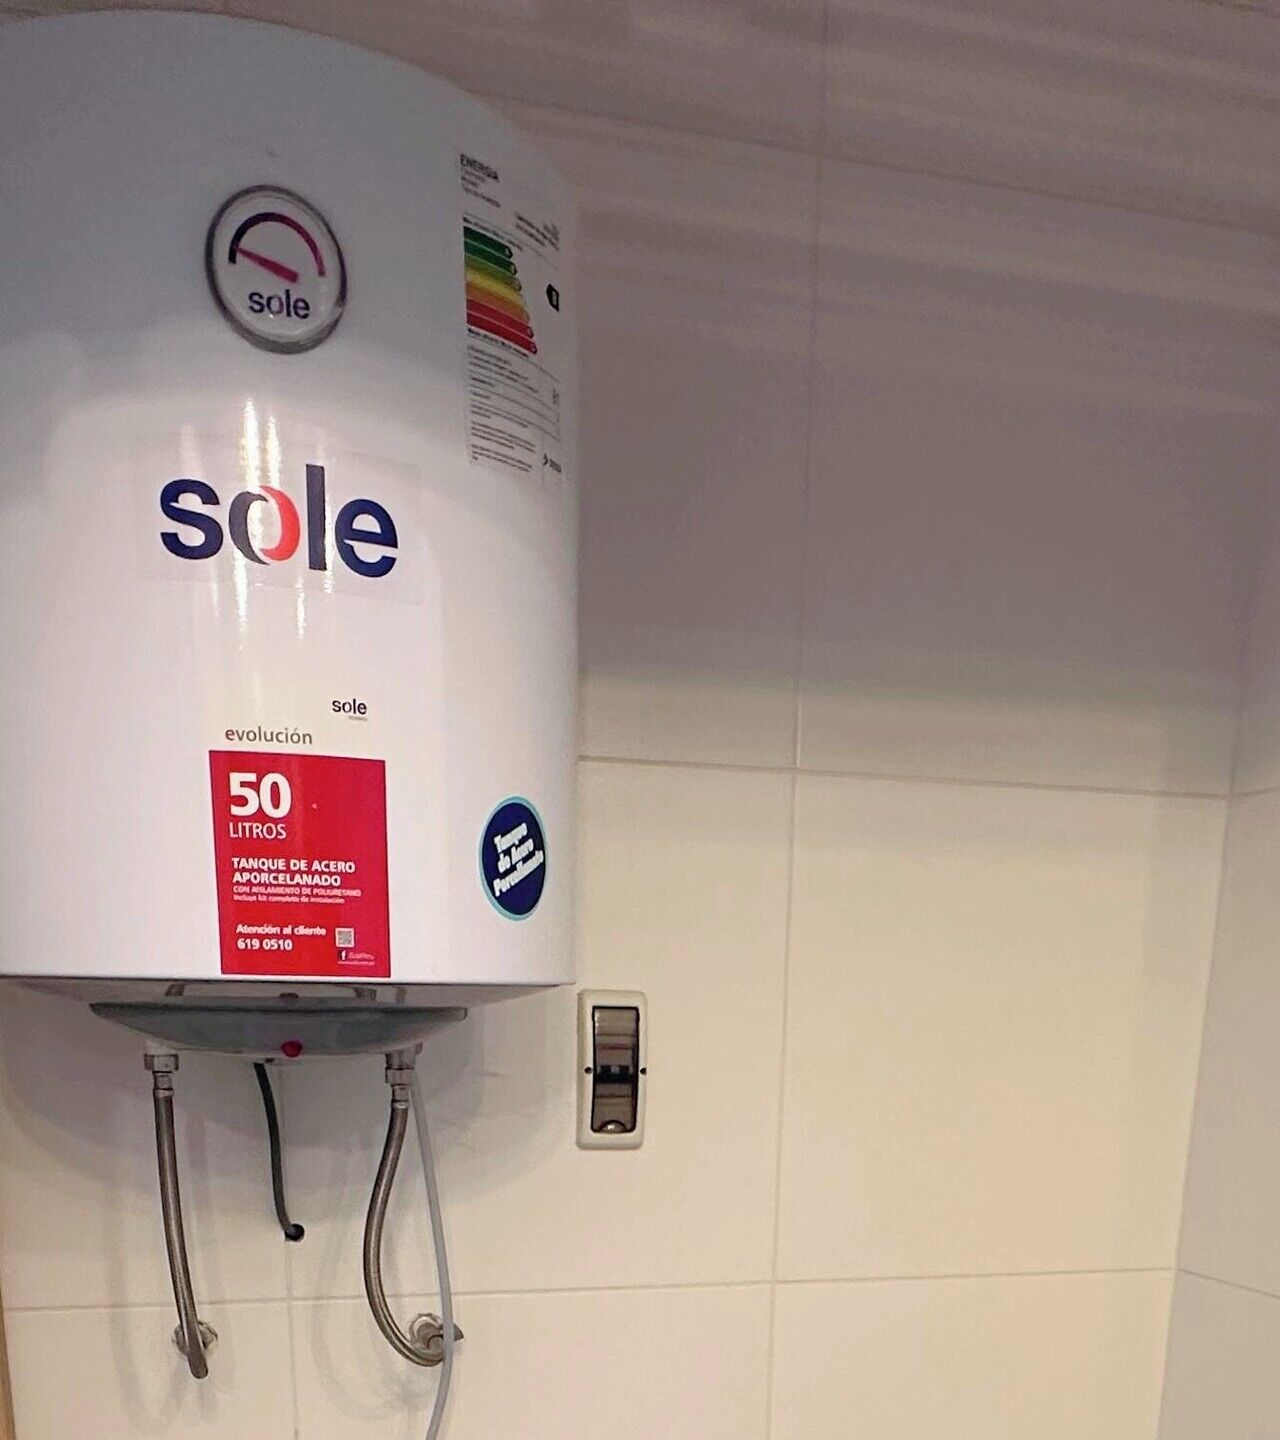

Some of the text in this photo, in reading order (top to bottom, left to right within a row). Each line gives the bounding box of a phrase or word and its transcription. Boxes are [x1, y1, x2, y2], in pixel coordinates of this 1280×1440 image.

[248, 289, 310, 319] sole
[160, 464, 398, 578] sole
[331, 698, 367, 715] sole
[225, 726, 313, 745] evolución
[229, 772, 291, 818] 50
[229, 821, 287, 840] LITROS
[232, 857, 356, 873] TANQUE DE ACERO
[232, 871, 342, 886] APORCELANADO
[236, 923, 327, 937] Atención al cliente
[236, 938, 293, 951] 619 0510
